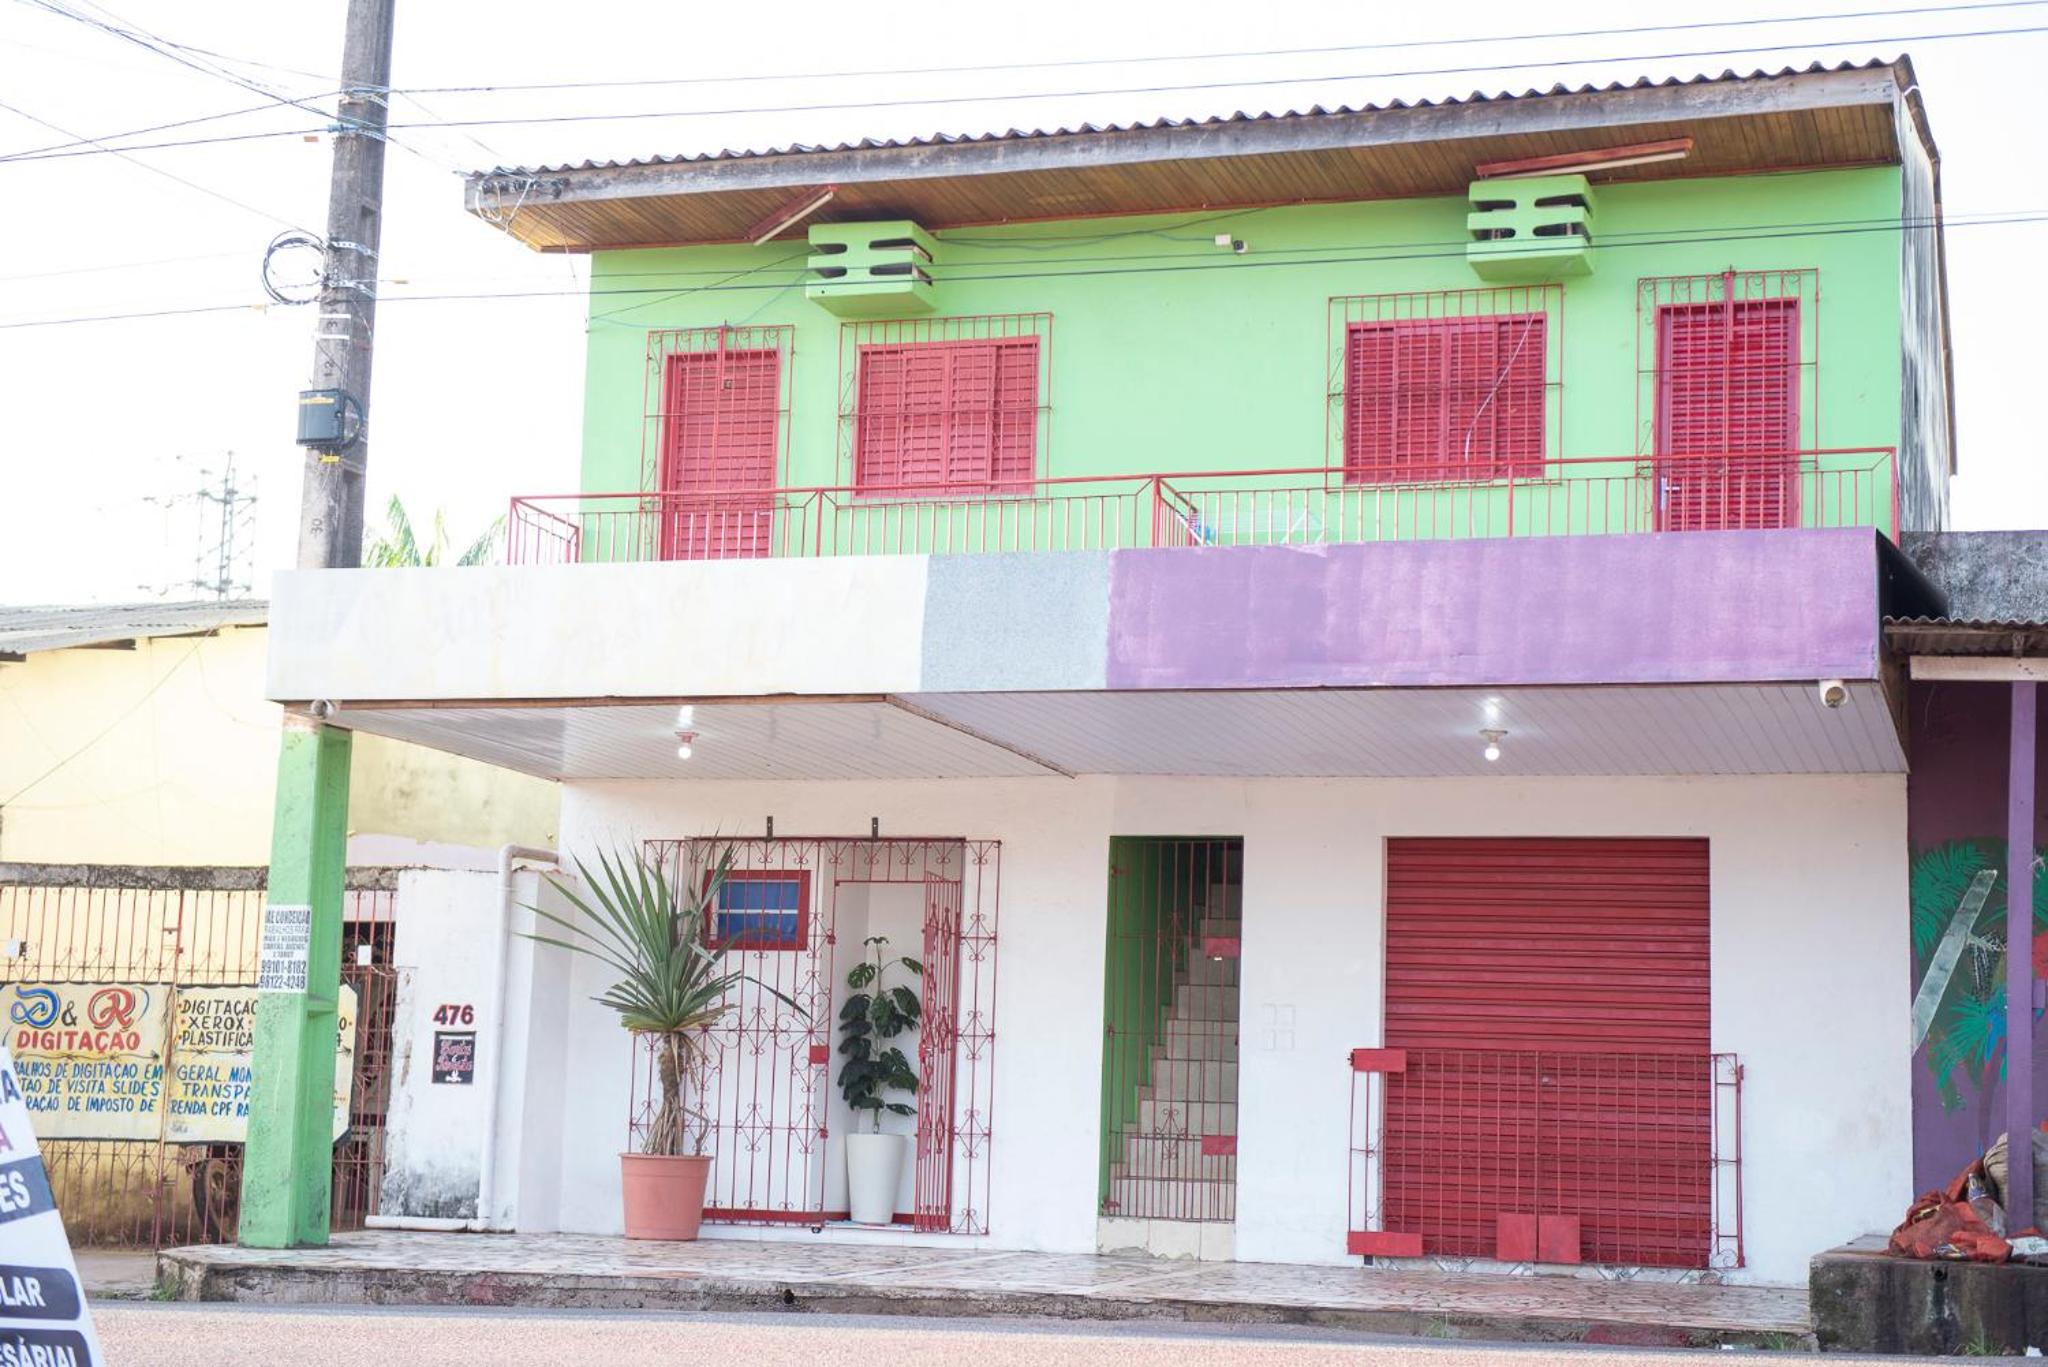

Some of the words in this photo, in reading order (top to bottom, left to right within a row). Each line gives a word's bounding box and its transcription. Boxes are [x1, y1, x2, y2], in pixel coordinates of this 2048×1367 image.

[62, 1001, 78, 1026] &
[433, 1004, 474, 1025] 476
[188, 1016, 244, 1031] XEROX
[55, 1063, 70, 1078] DE
[144, 1064, 164, 1081] EM
[47, 1078, 62, 1094] DE
[68, 1079, 106, 1094] VISITA
[113, 1080, 160, 1097] SLIDES
[68, 1096, 81, 1111] DE
[85, 1096, 135, 1112] IMPOSTO
[140, 1098, 157, 1112] DE
[170, 1099, 207, 1115] RENDA
[211, 1100, 233, 1116] CPF
[0, 1276, 47, 1307] LAR
